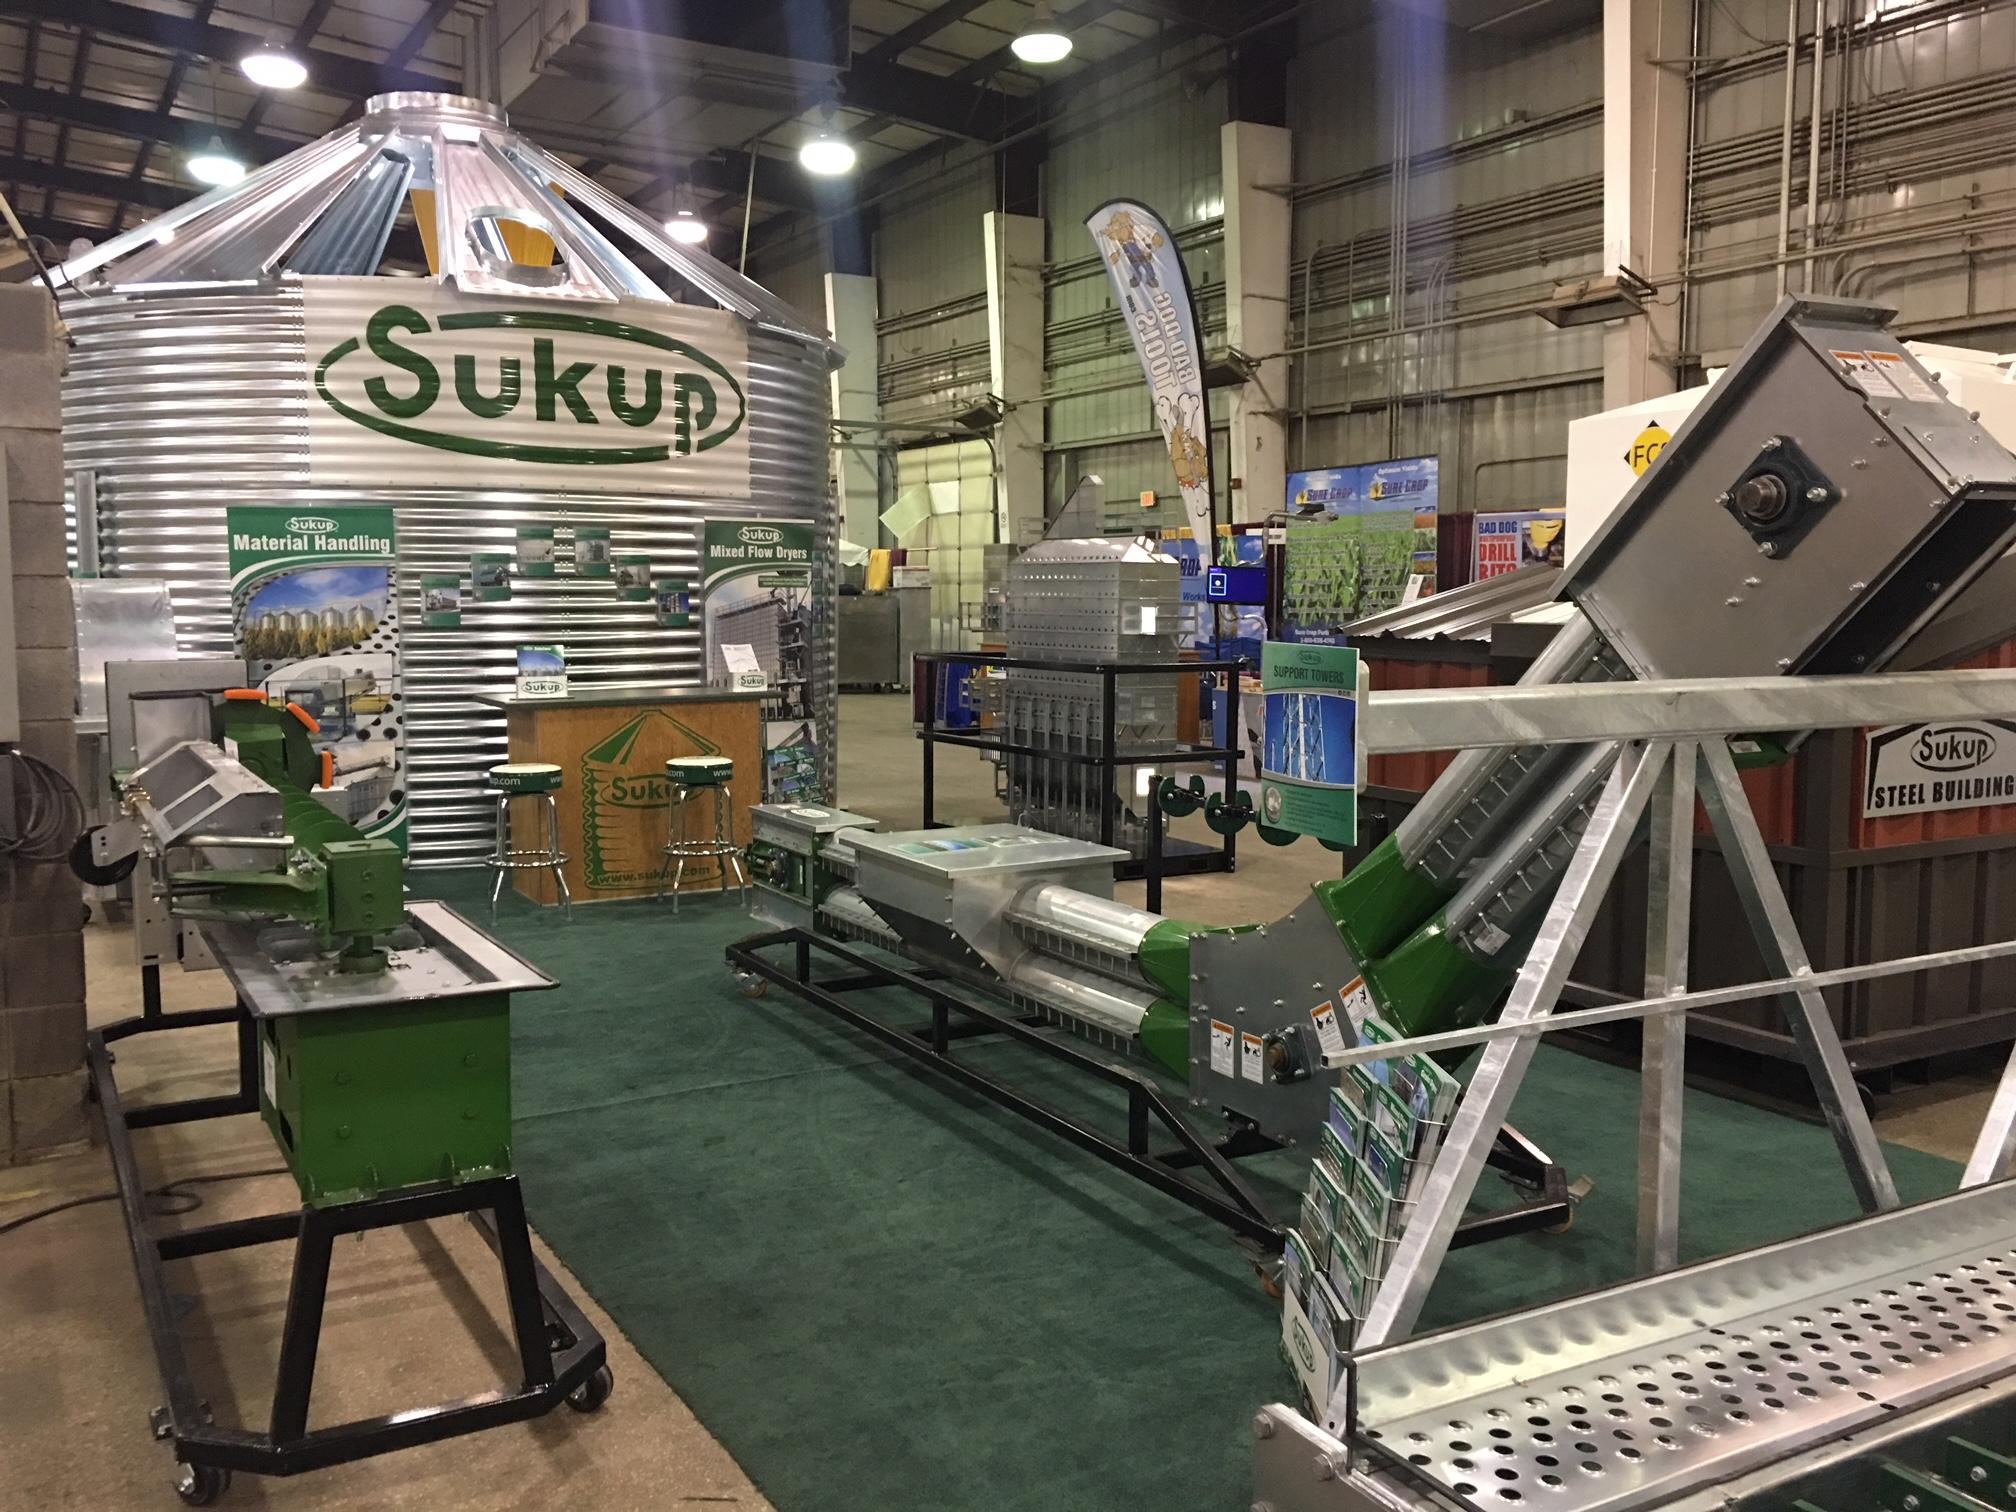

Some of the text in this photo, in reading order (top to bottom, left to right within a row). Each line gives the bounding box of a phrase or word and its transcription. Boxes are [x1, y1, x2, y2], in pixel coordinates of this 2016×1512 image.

[363, 304, 718, 459] Sukup
[290, 516, 335, 532] Sukup
[1479, 521, 1517, 534] BAD DOG
[233, 534, 390, 554] Material Handling
[741, 526, 780, 543] Sukup
[710, 545, 808, 561] Mixed Flow Dryers
[1479, 543, 1517, 562] DRILL
[1273, 665, 1345, 685] SUPPORT TOWERS
[524, 681, 560, 693] Sukup
[1919, 729, 1988, 766] Sukup
[611, 776, 684, 802] Suku
[1875, 774, 2016, 809] STEEL BUILDING
